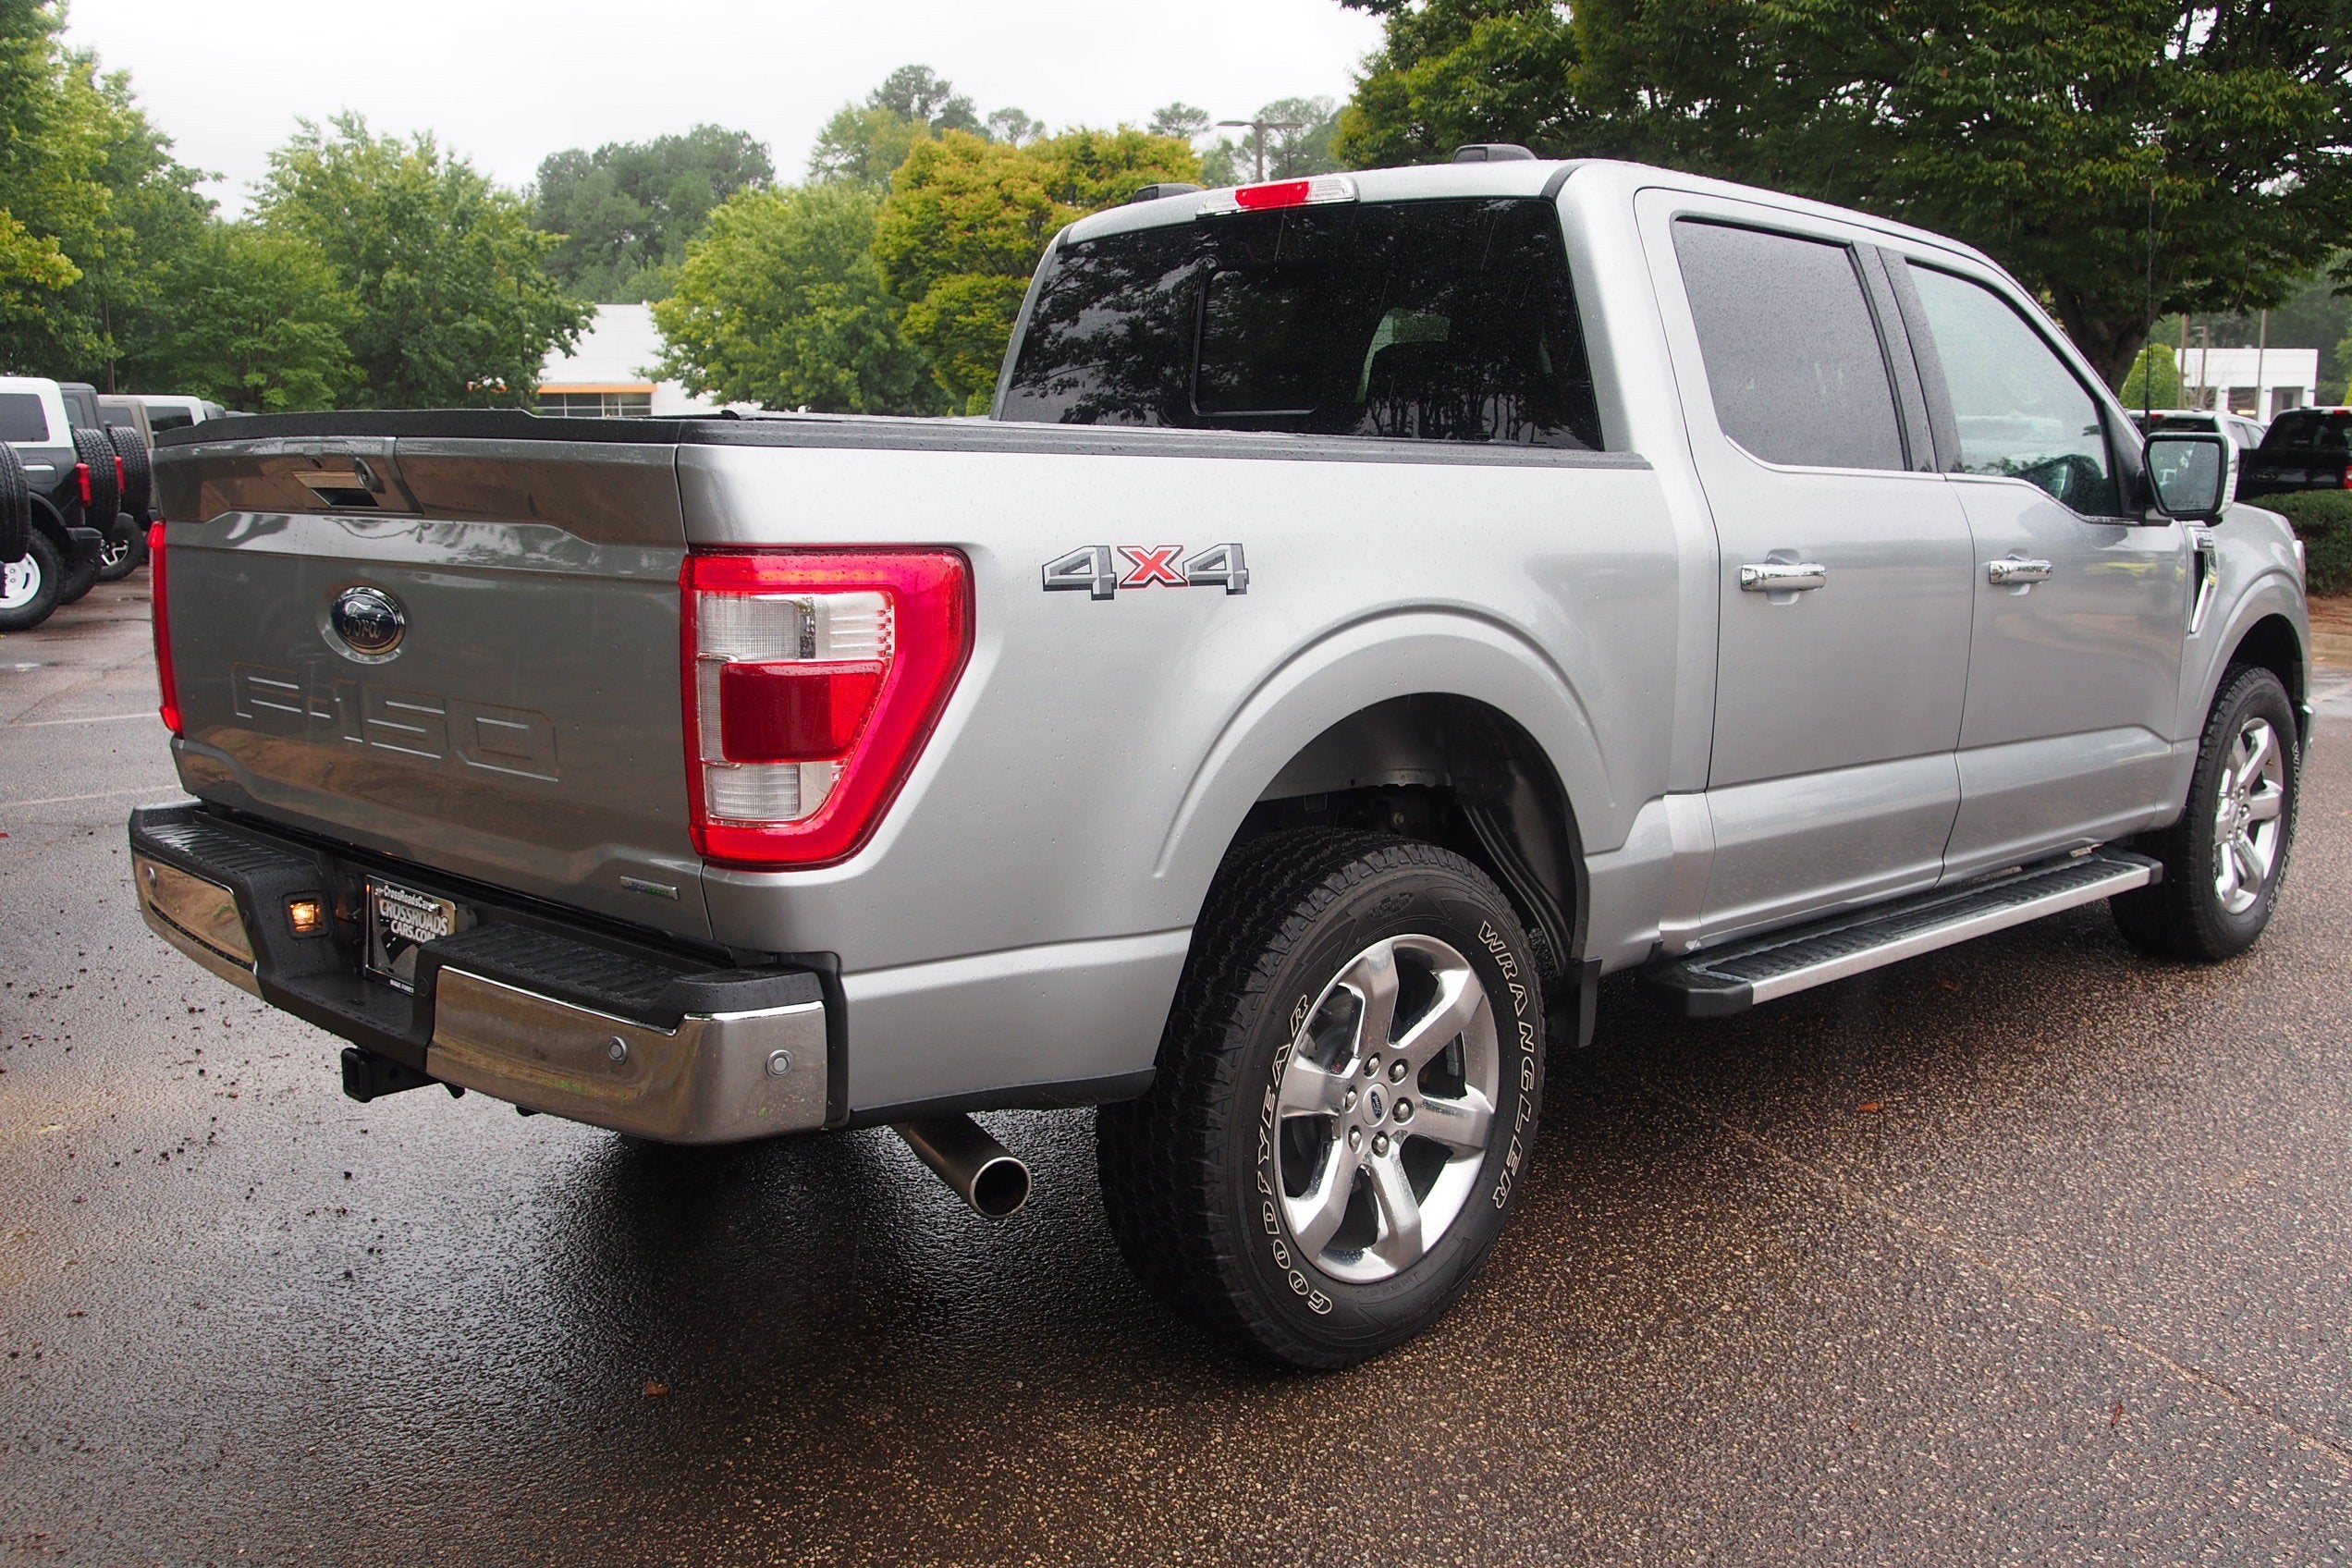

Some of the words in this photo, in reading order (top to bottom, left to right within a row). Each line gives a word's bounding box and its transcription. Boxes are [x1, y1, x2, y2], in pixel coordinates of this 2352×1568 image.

[1042, 543, 1250, 601] 4X4
[343, 600, 382, 639] Ford
[231, 661, 558, 782] F-150
[380, 900, 448, 937] CROSSROADS
[1477, 920, 1534, 1208] WRANGLER
[1257, 994, 1333, 1315] GOODYEAR
